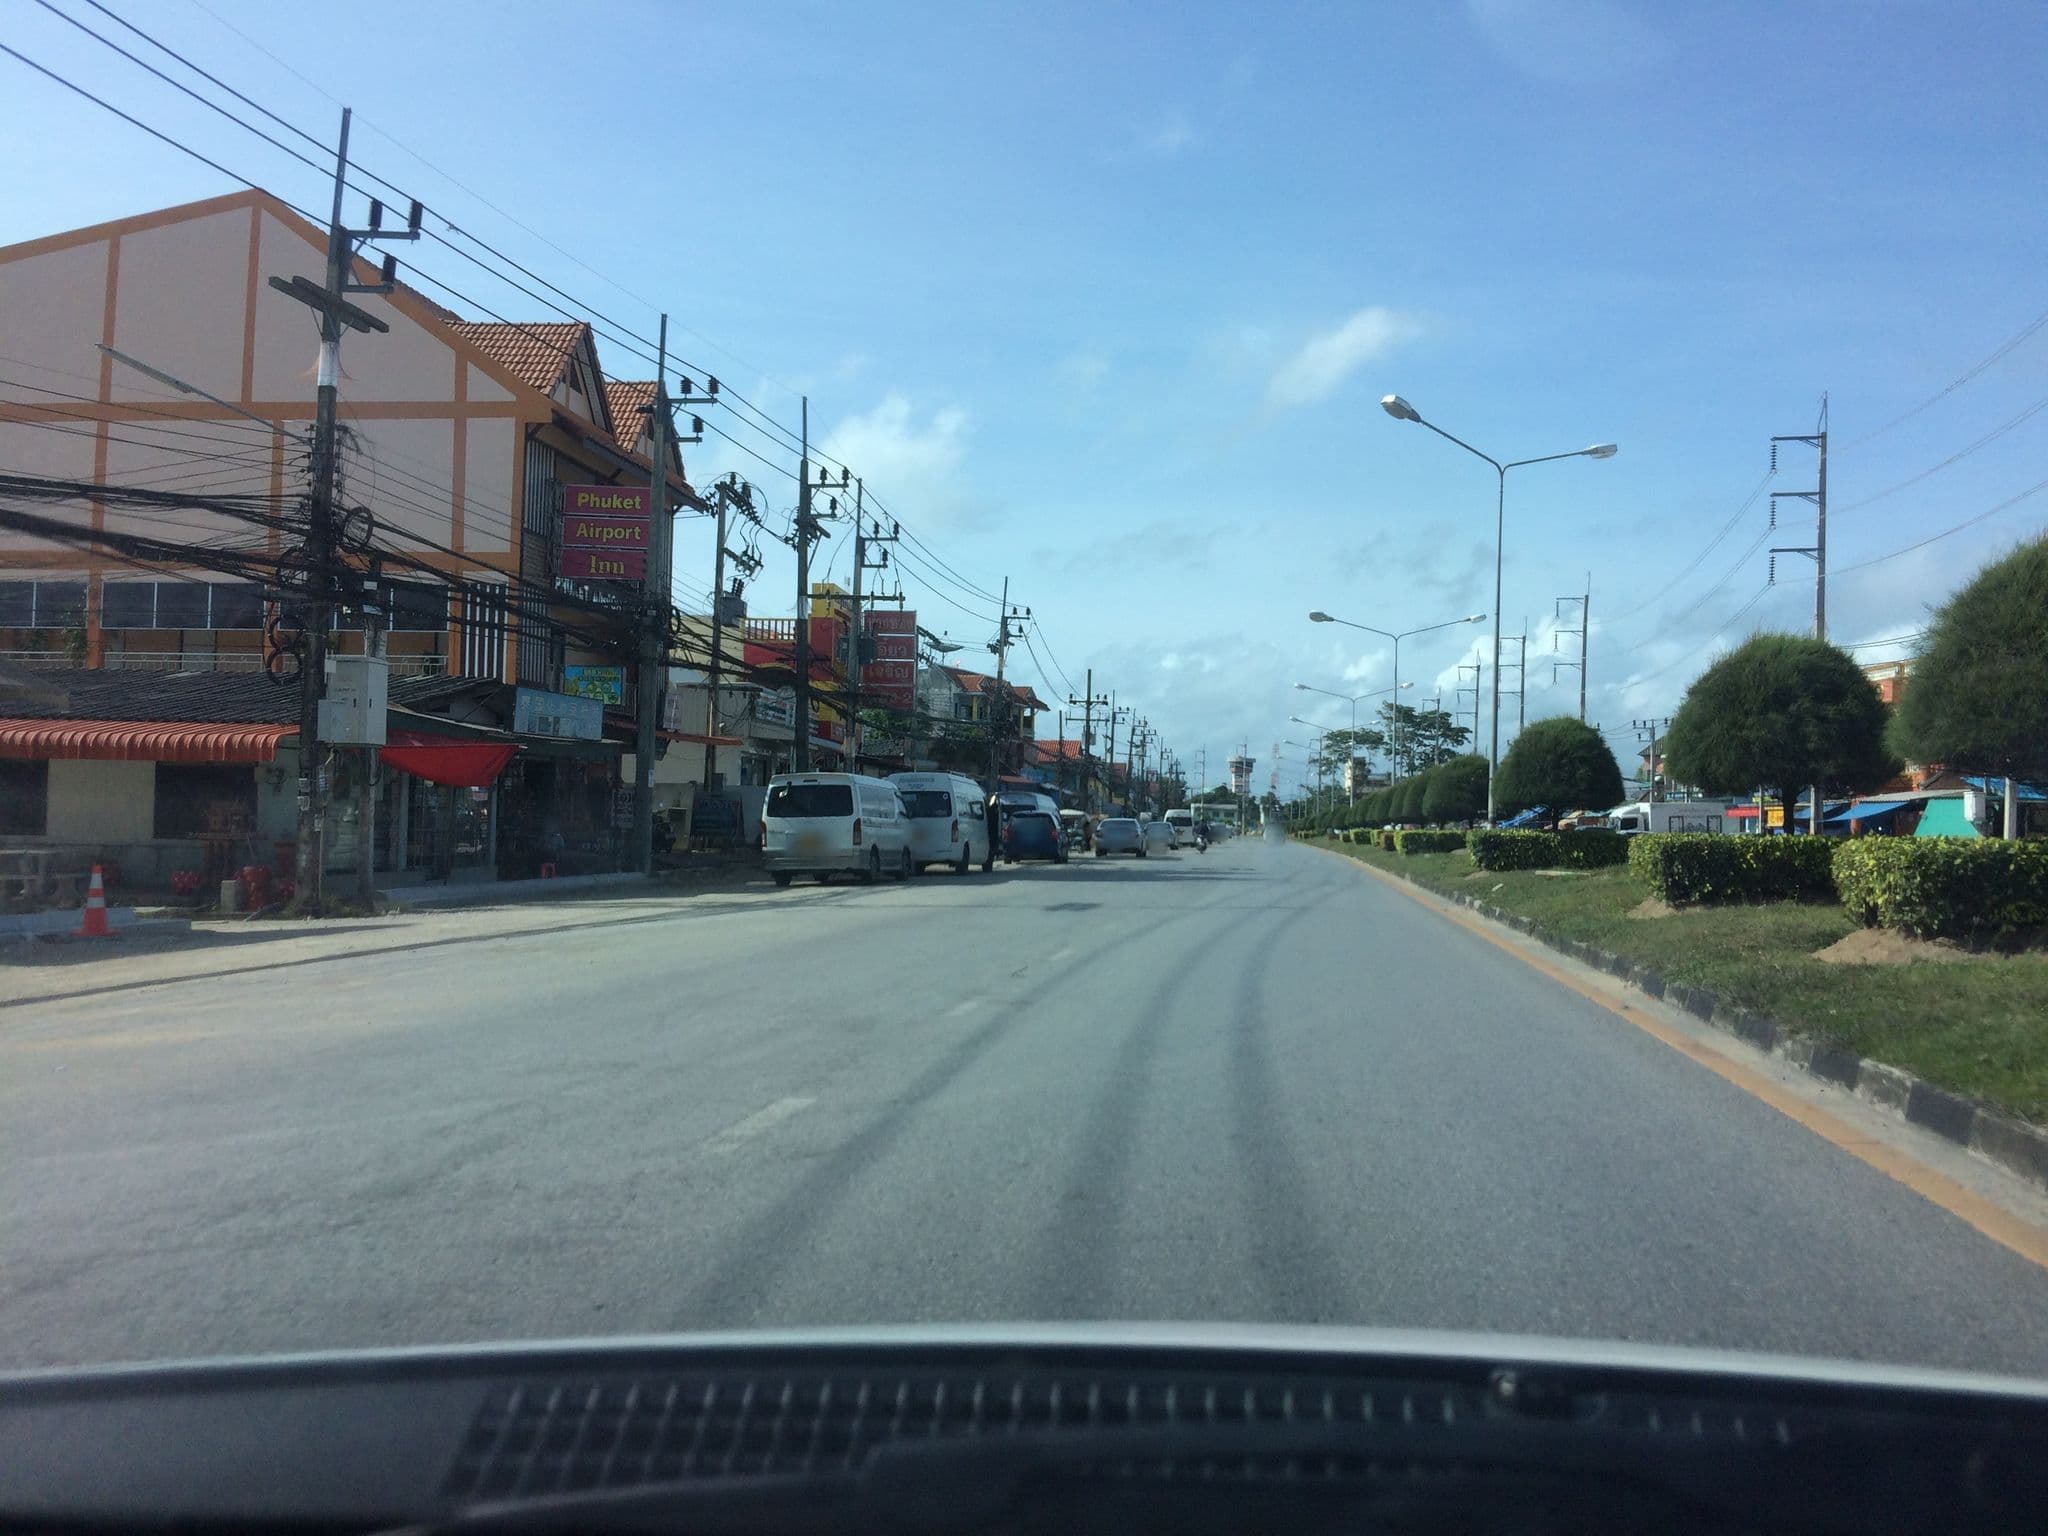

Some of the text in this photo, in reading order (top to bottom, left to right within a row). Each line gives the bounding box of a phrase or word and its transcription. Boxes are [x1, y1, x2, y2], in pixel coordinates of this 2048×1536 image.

[577, 492, 642, 510] Phuket
[576, 522, 642, 543] Airport
[589, 554, 625, 575] Inn
